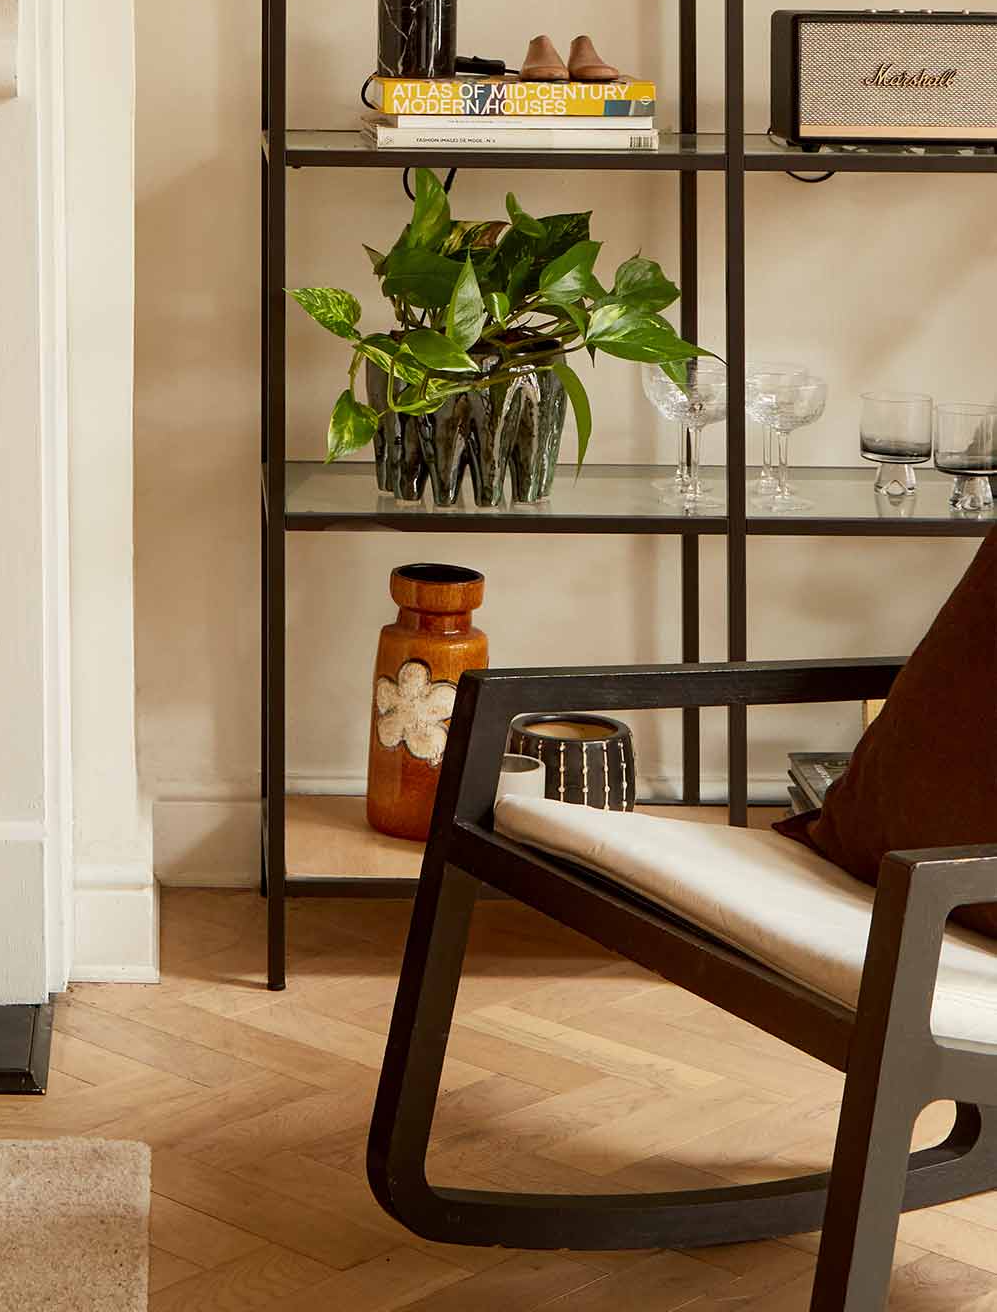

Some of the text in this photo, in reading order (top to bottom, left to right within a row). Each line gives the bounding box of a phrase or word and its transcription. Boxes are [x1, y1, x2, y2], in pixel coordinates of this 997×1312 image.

[862, 63, 957, 88] Marshall
[391, 84, 630, 100] ATLAS OF MID-CENTURY
[392, 99, 567, 115] MODERN HOUSES
